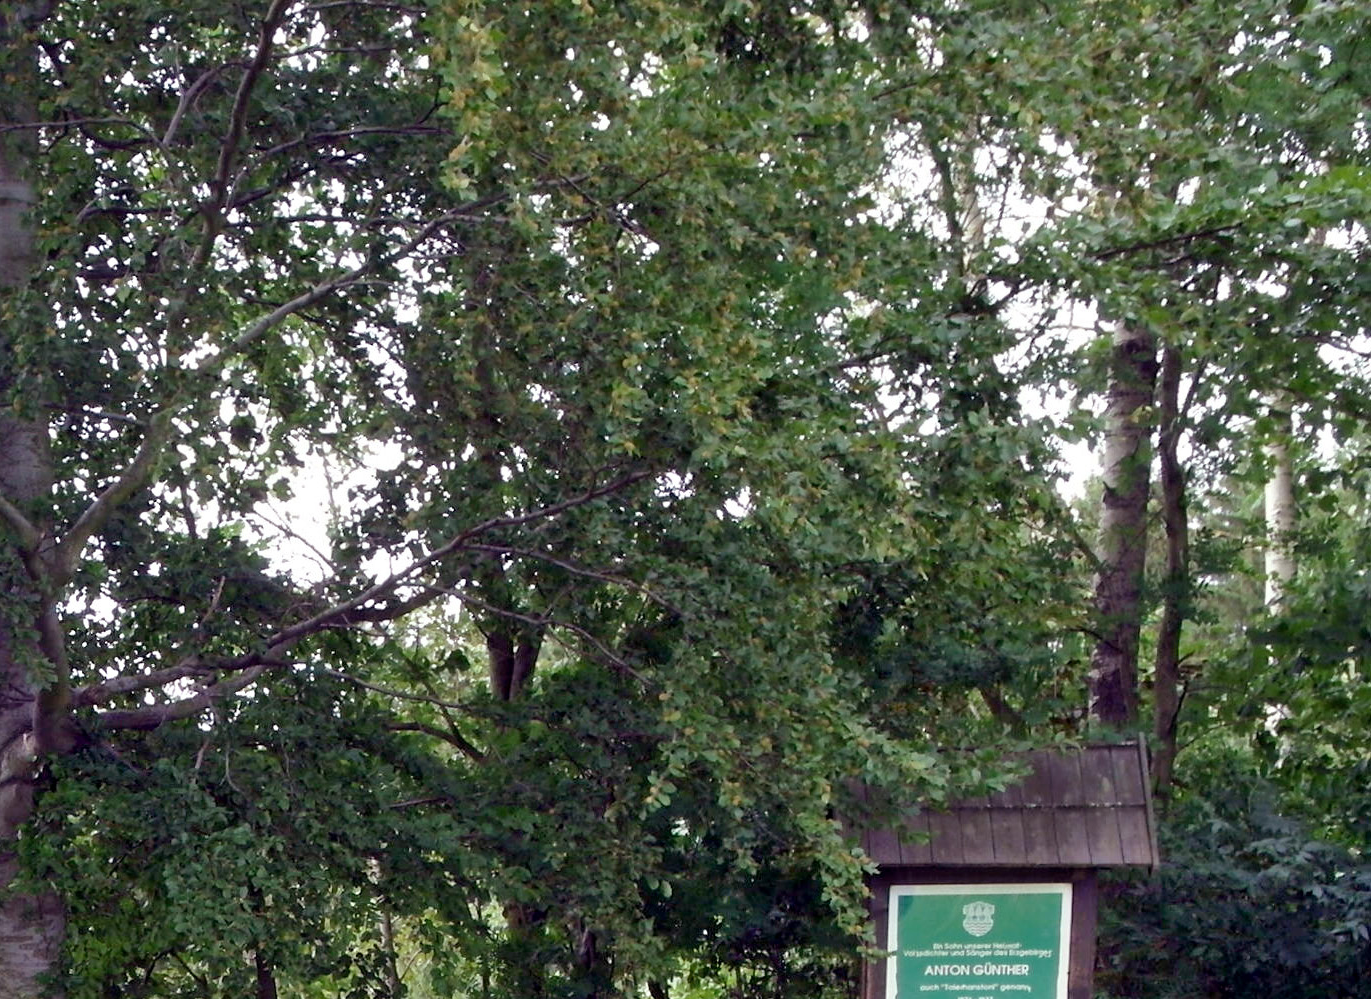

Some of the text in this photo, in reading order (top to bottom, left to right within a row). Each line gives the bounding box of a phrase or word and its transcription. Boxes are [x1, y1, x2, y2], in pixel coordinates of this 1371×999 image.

[950, 949, 965, 957] und
[924, 961, 1029, 977] ANTON GÜNTHER
[920, 983, 939, 991] auch
